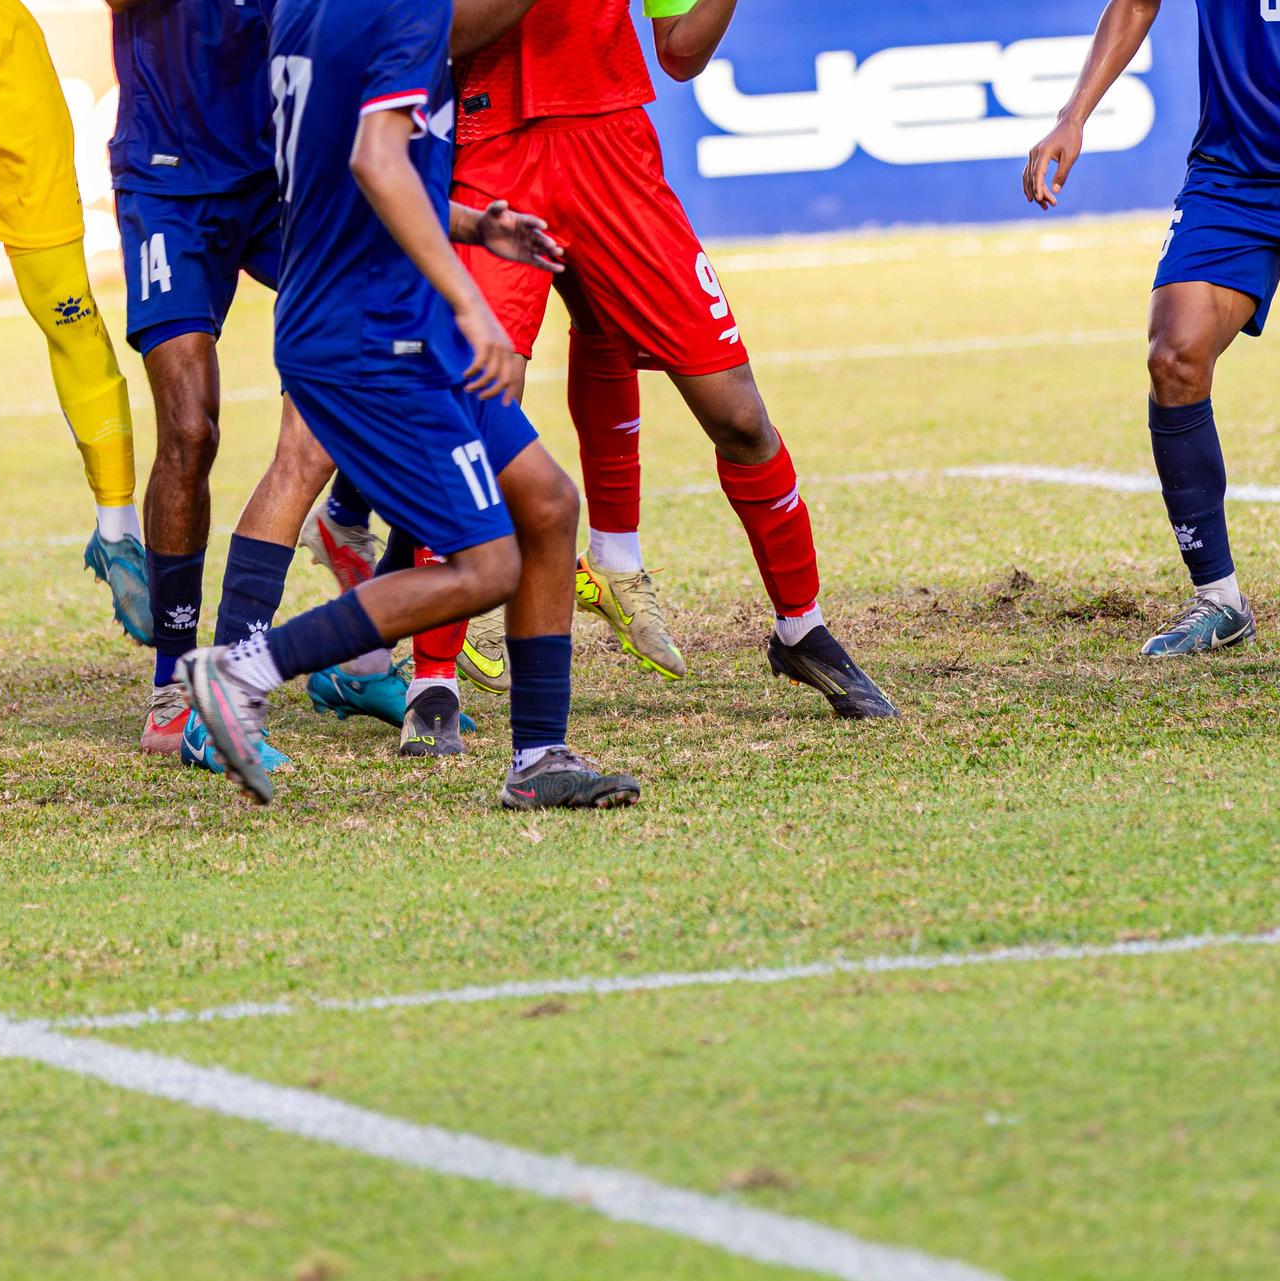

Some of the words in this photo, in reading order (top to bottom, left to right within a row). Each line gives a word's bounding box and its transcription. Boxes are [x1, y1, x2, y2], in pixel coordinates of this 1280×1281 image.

[139, 232, 173, 302] 14
[694, 251, 728, 320] 9
[55, 308, 91, 326] KELME
[451, 439, 501, 511] 17
[1180, 539, 1204, 551] ELME
[163, 621, 198, 631] KELME
